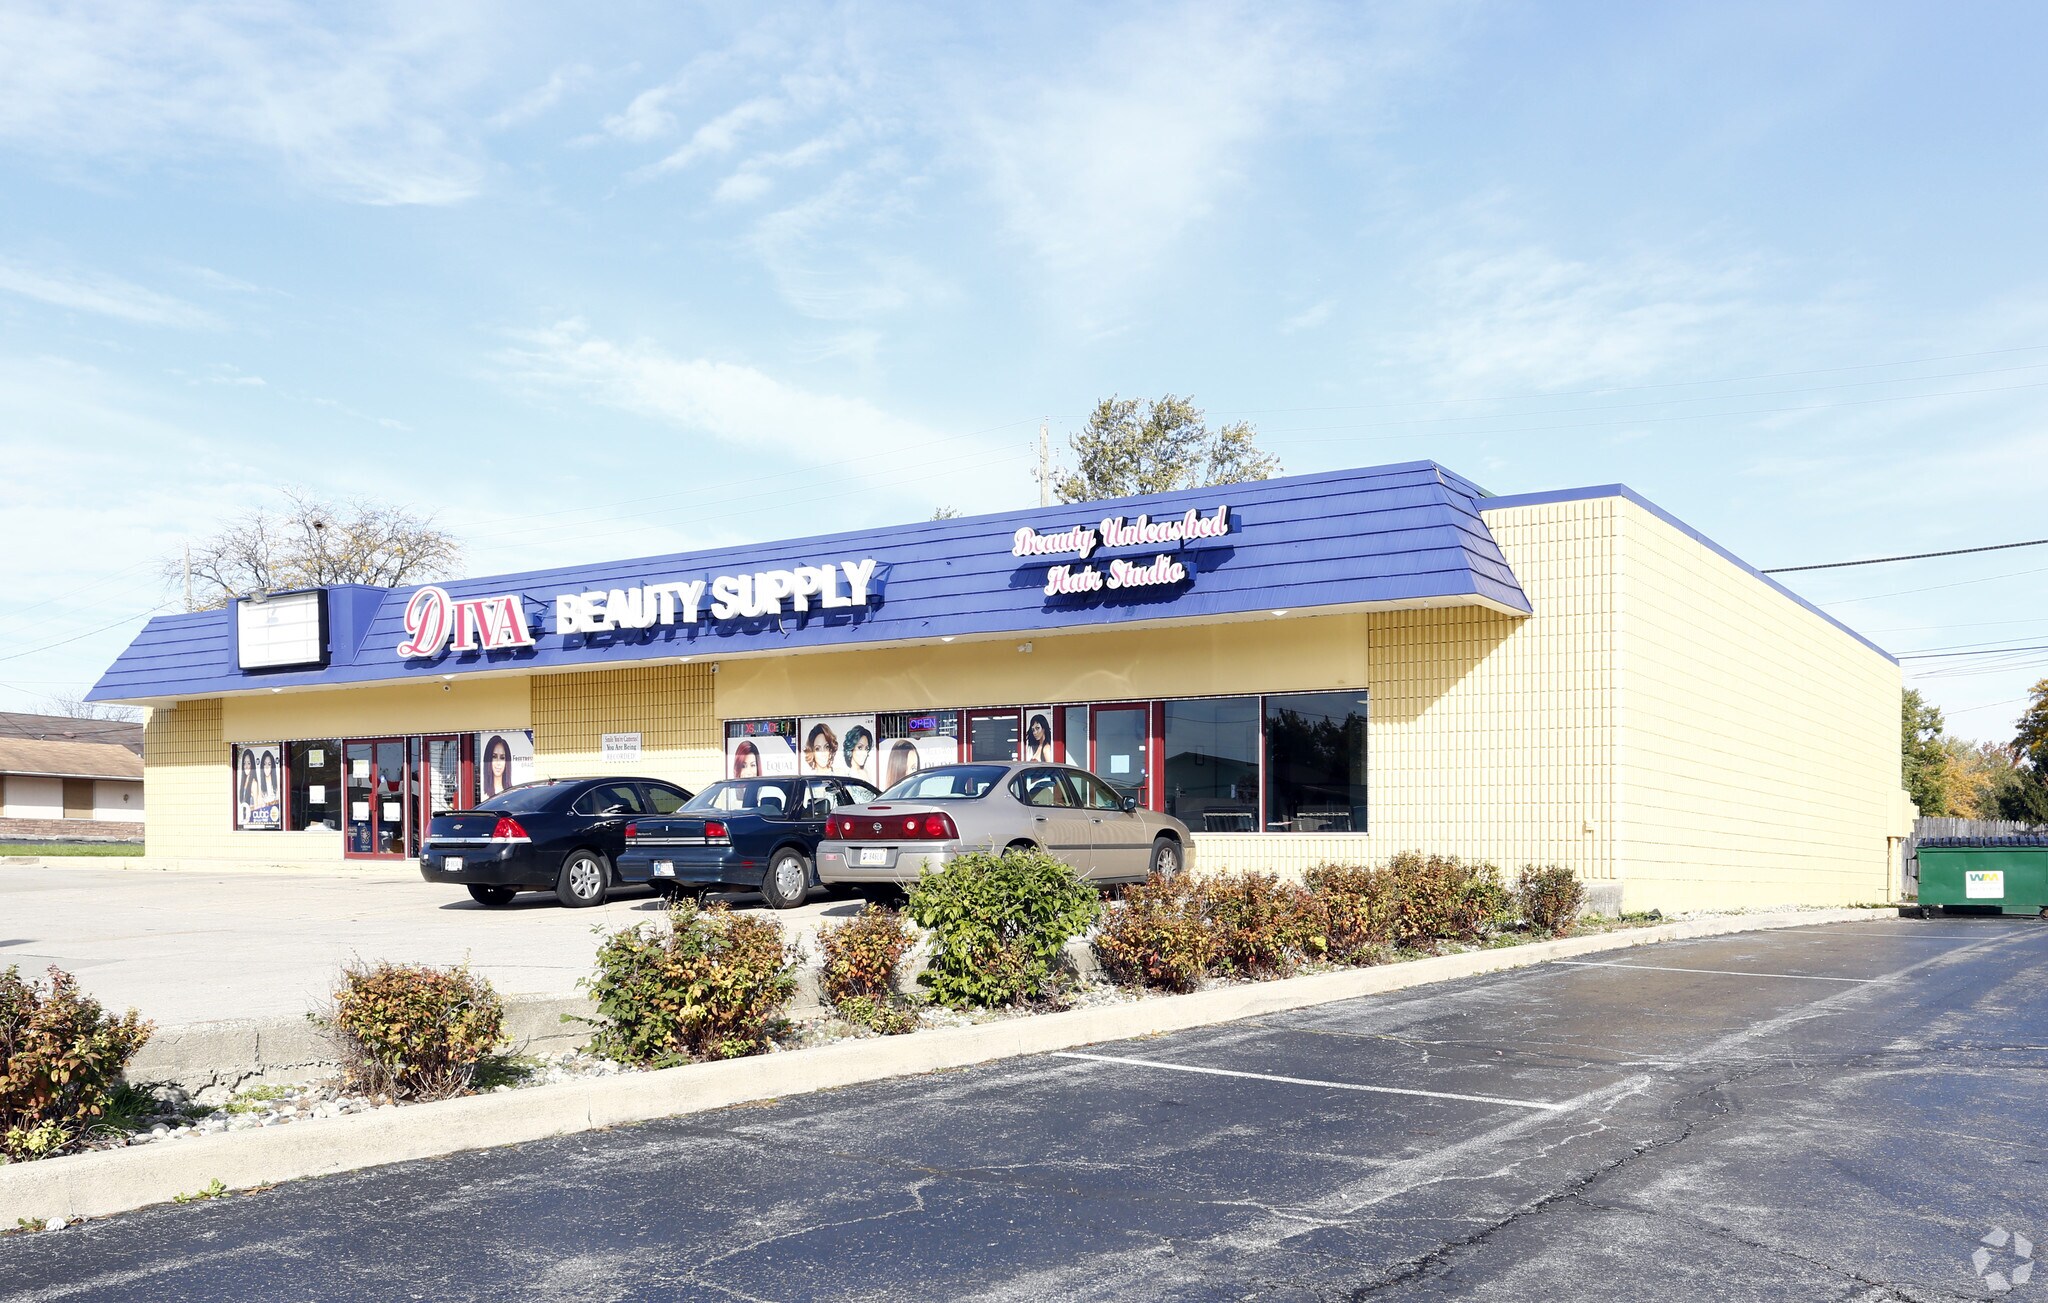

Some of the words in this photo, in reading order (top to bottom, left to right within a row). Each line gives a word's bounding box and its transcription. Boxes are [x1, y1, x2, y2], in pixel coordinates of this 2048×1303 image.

[1012, 527, 1096, 559] Beauty
[1100, 505, 1228, 547] Unleashed
[1044, 565, 1102, 596] Hair
[1107, 554, 1185, 589] Studio
[556, 579, 706, 635] BEAUTY
[711, 559, 877, 620] SUPPLY
[910, 718, 936, 729] OPEN
[606, 743, 614, 751] You
[624, 743, 637, 751] Being
[1969, 873, 1999, 881] WM
